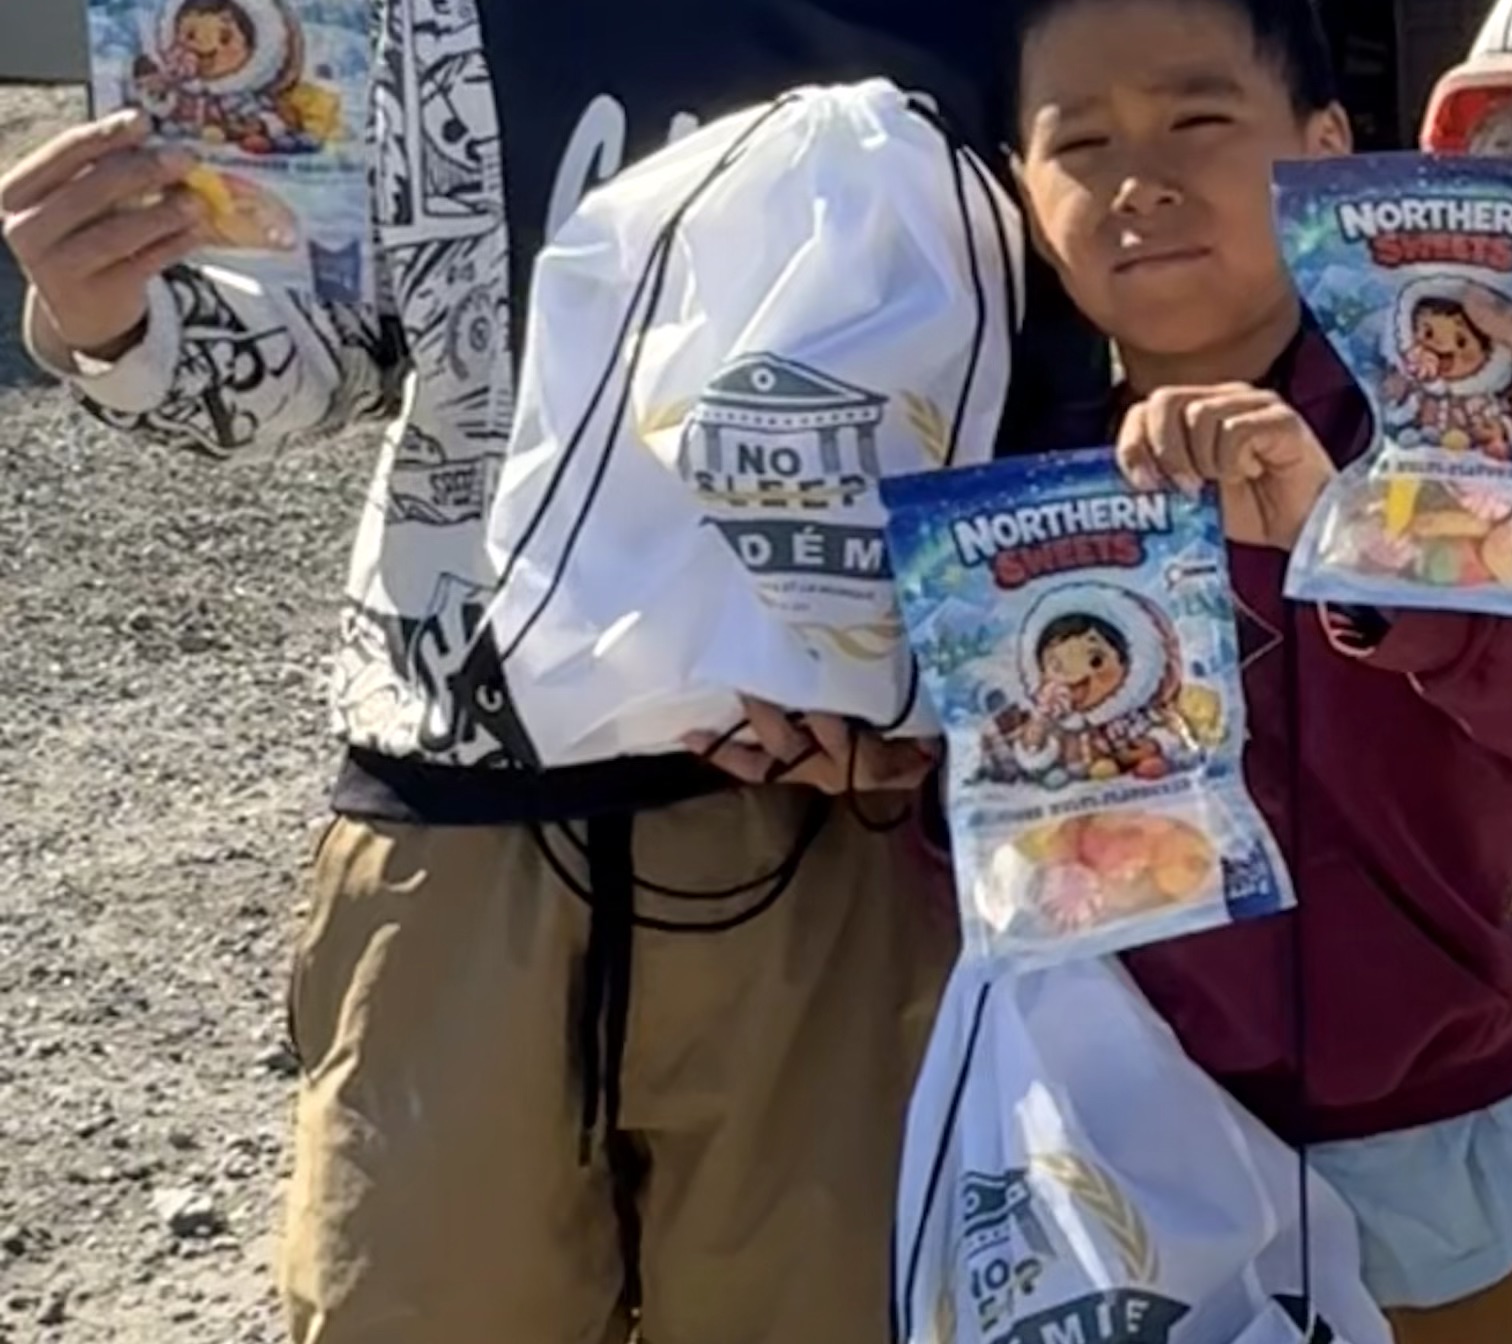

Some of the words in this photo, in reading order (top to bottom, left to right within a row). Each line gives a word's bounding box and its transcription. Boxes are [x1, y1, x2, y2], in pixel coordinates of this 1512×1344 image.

[737, 442, 802, 477] NO
[955, 493, 1170, 565] NORTHERN
[995, 536, 1142, 587] SWEETS
